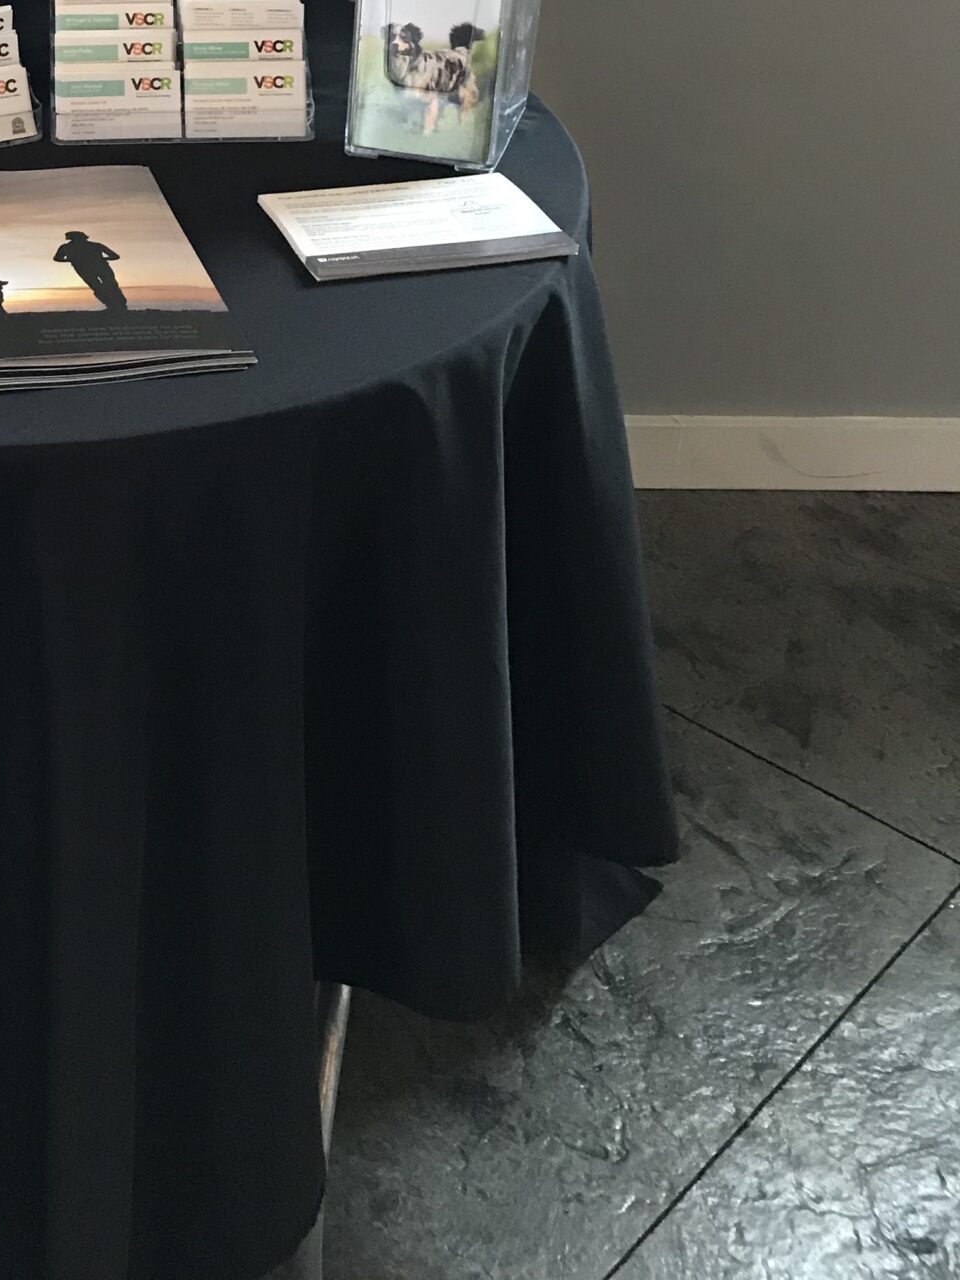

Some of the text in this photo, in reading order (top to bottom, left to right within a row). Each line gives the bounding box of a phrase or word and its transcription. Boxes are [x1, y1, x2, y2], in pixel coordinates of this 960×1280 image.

[125, 12, 165, 26] VSCR
[123, 42, 162, 56] VSCR
[254, 39, 294, 53] VSCR
[131, 77, 172, 91] VSCR
[253, 75, 294, 89] VSCR
